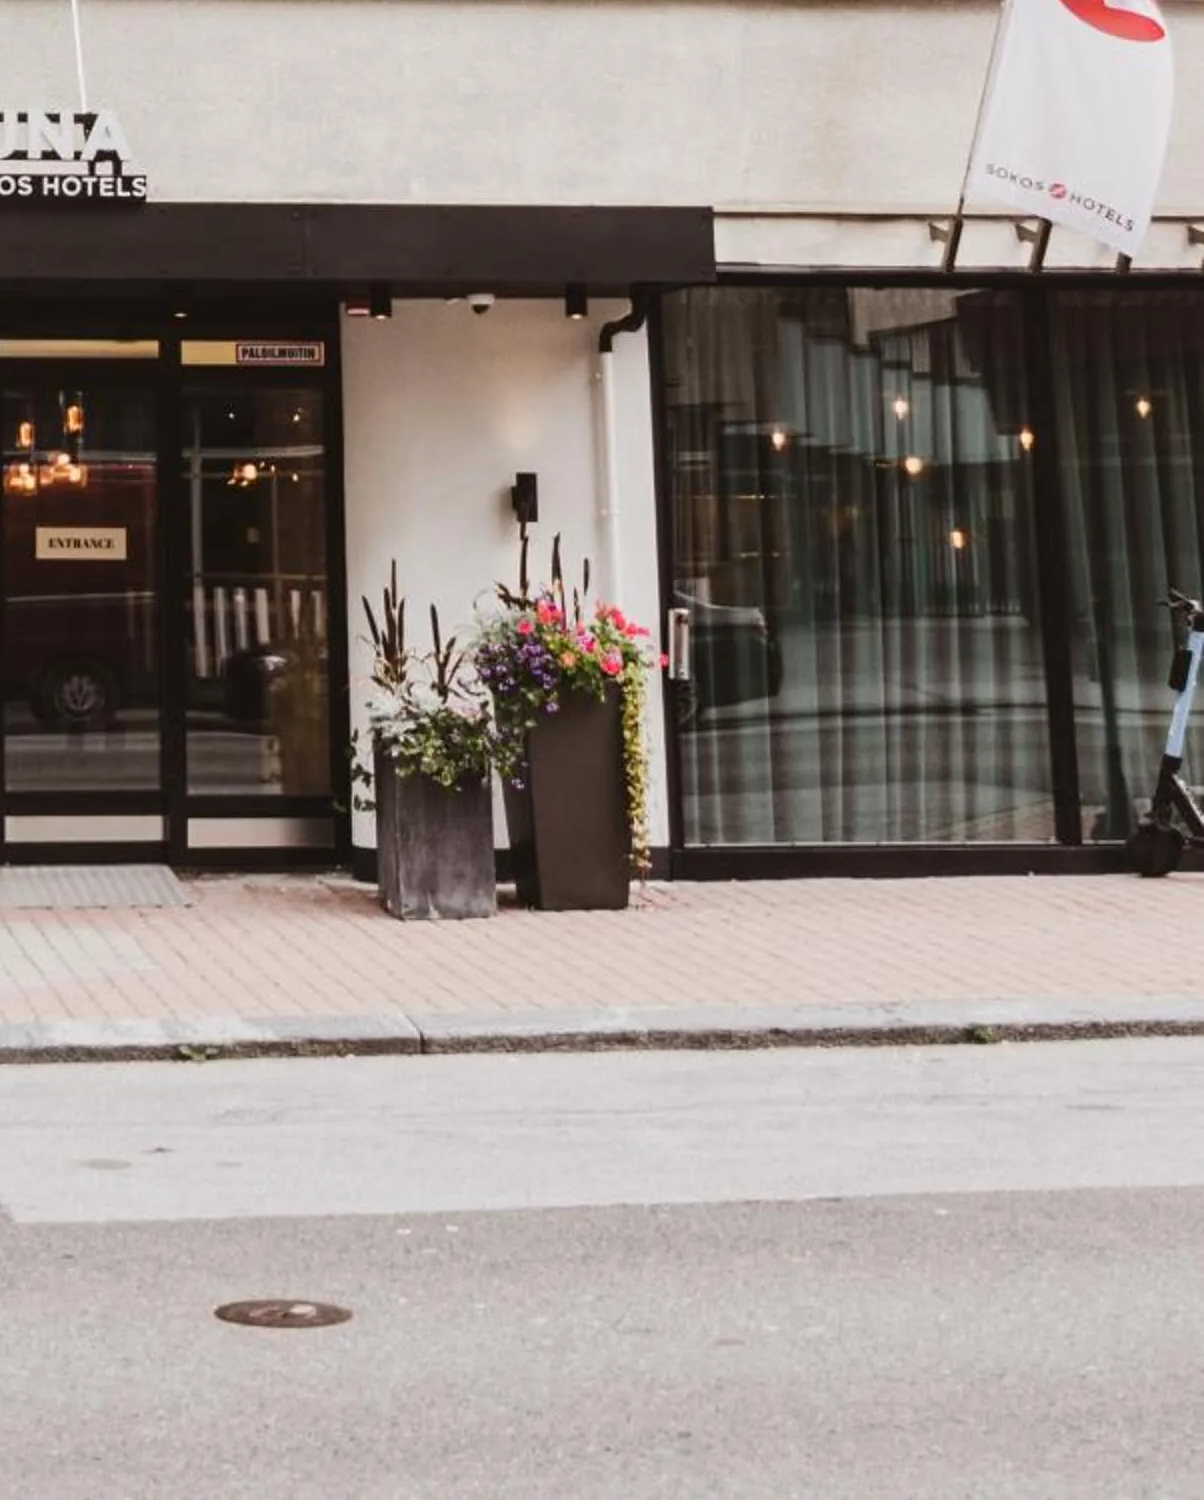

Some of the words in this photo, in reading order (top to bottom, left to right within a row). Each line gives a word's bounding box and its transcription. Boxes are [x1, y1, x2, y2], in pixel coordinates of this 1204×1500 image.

[42, 176, 146, 197] HOTELS
[985, 162, 1045, 192] SOKOS
[1069, 192, 1135, 232] HOTELS
[48, 537, 115, 549] ENTRANCE
